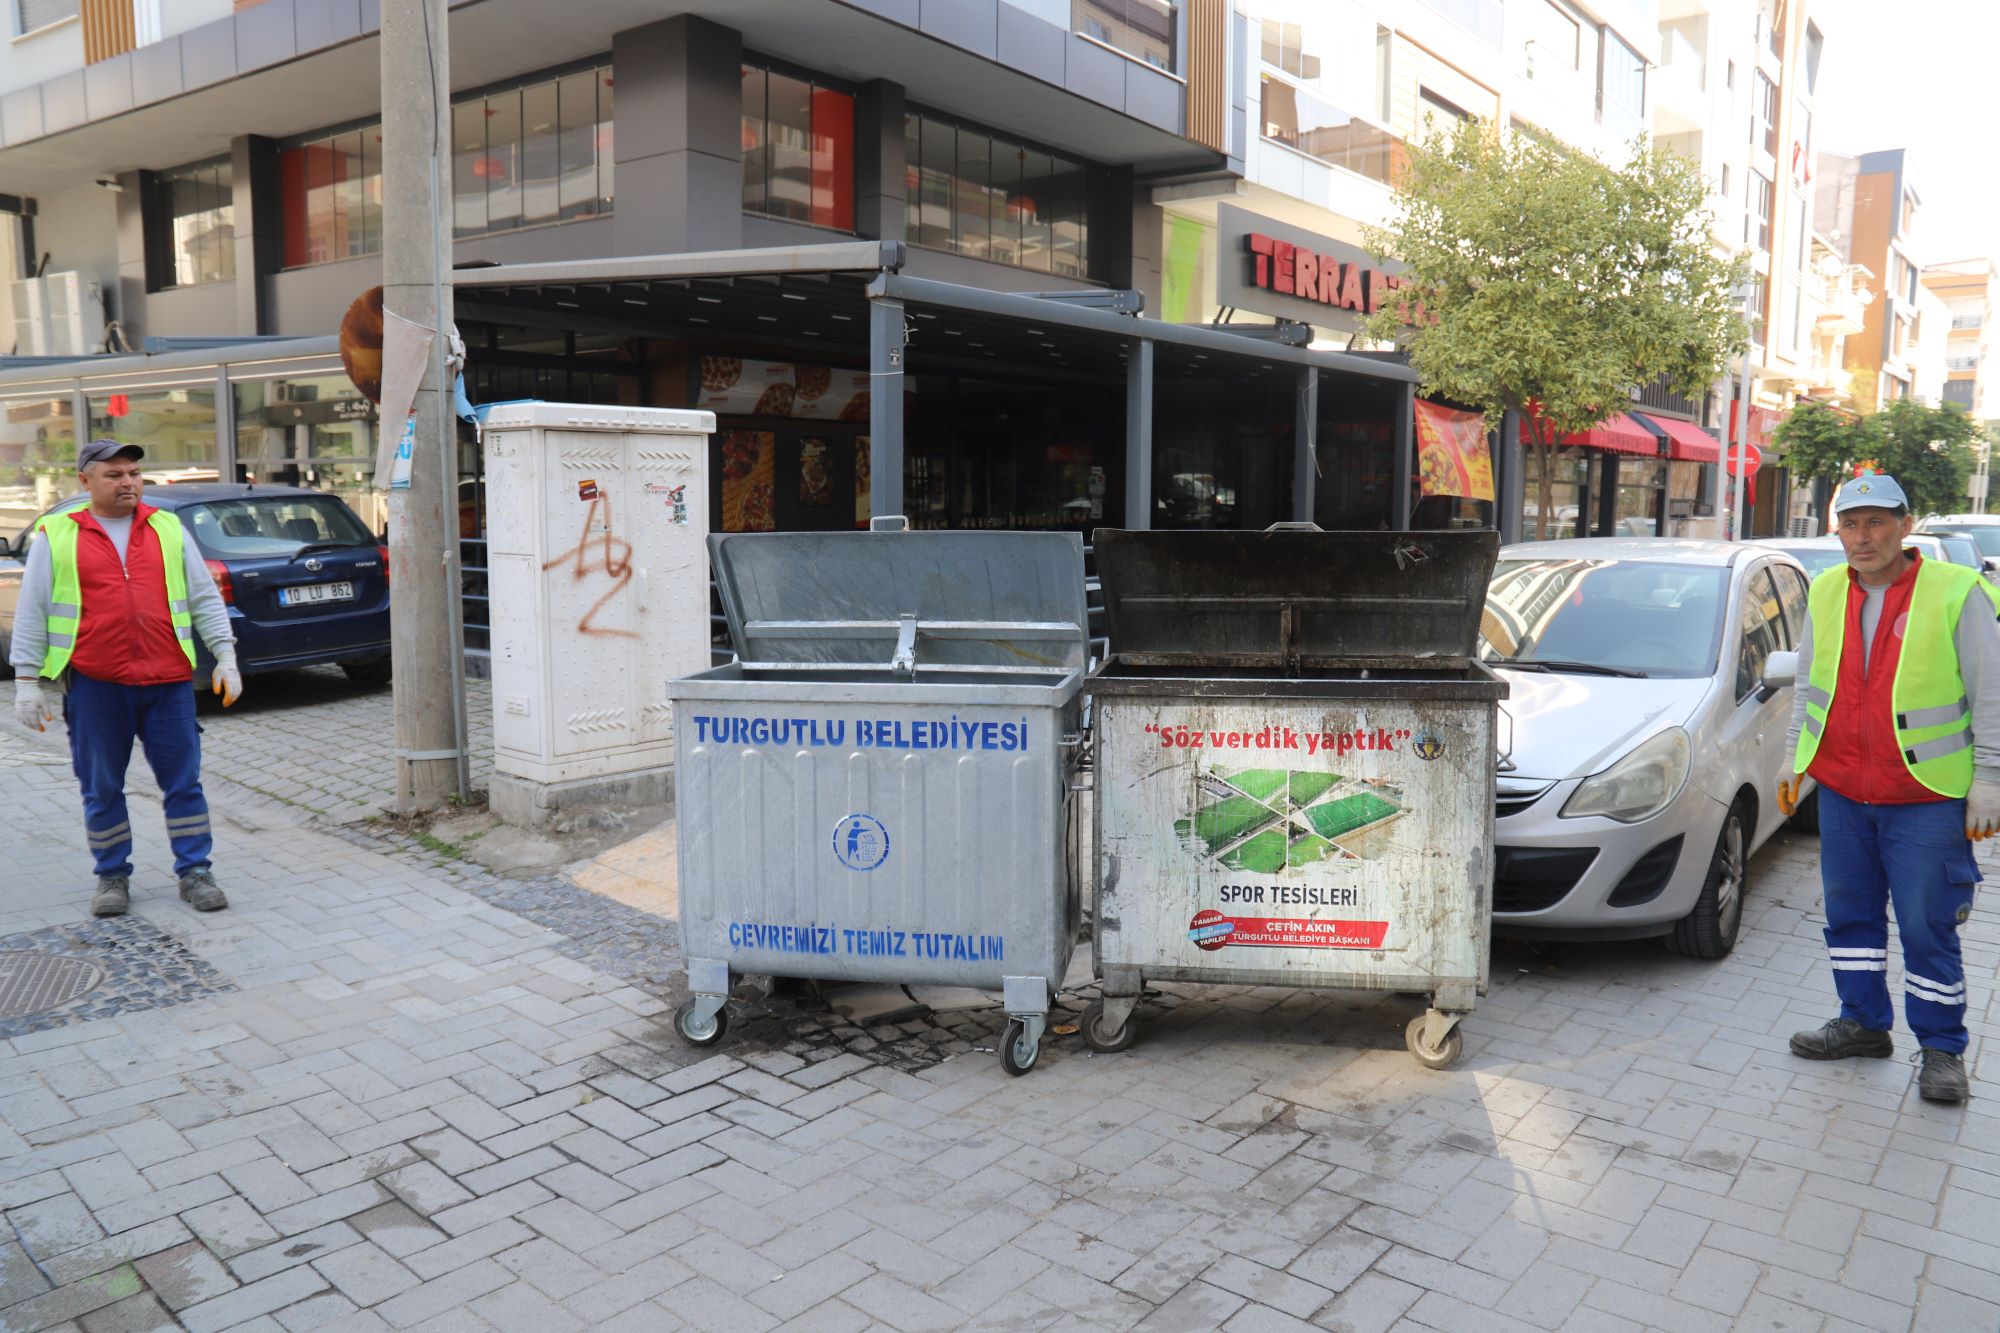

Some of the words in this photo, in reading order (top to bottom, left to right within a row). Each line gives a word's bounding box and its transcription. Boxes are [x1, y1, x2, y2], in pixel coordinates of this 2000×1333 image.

[1245, 232, 1363, 312] TERRA
[288, 588, 300, 601] 10
[309, 586, 323, 600] LU
[332, 583, 351, 597] 862
[693, 716, 845, 747] TURGUTLU
[856, 715, 1027, 751] BELEDİYESİ
[1144, 723, 1204, 749] “Söz
[1210, 725, 1299, 750] verdik
[1220, 885, 1264, 904] SPOR
[1271, 883, 1358, 906] TESİSLERİ
[1233, 932, 1281, 942] TURGUTLU
[1283, 933, 1327, 944] BELEDİYE
[1329, 935, 1370, 946] BAŞKANI
[1266, 921, 1302, 934] ÇETİN
[1305, 923, 1336, 933] AKIN
[729, 922, 837, 954] ÇEVREMİZİ
[843, 925, 906, 956] TEMİZ
[912, 932, 1004, 961] TUTALIM
